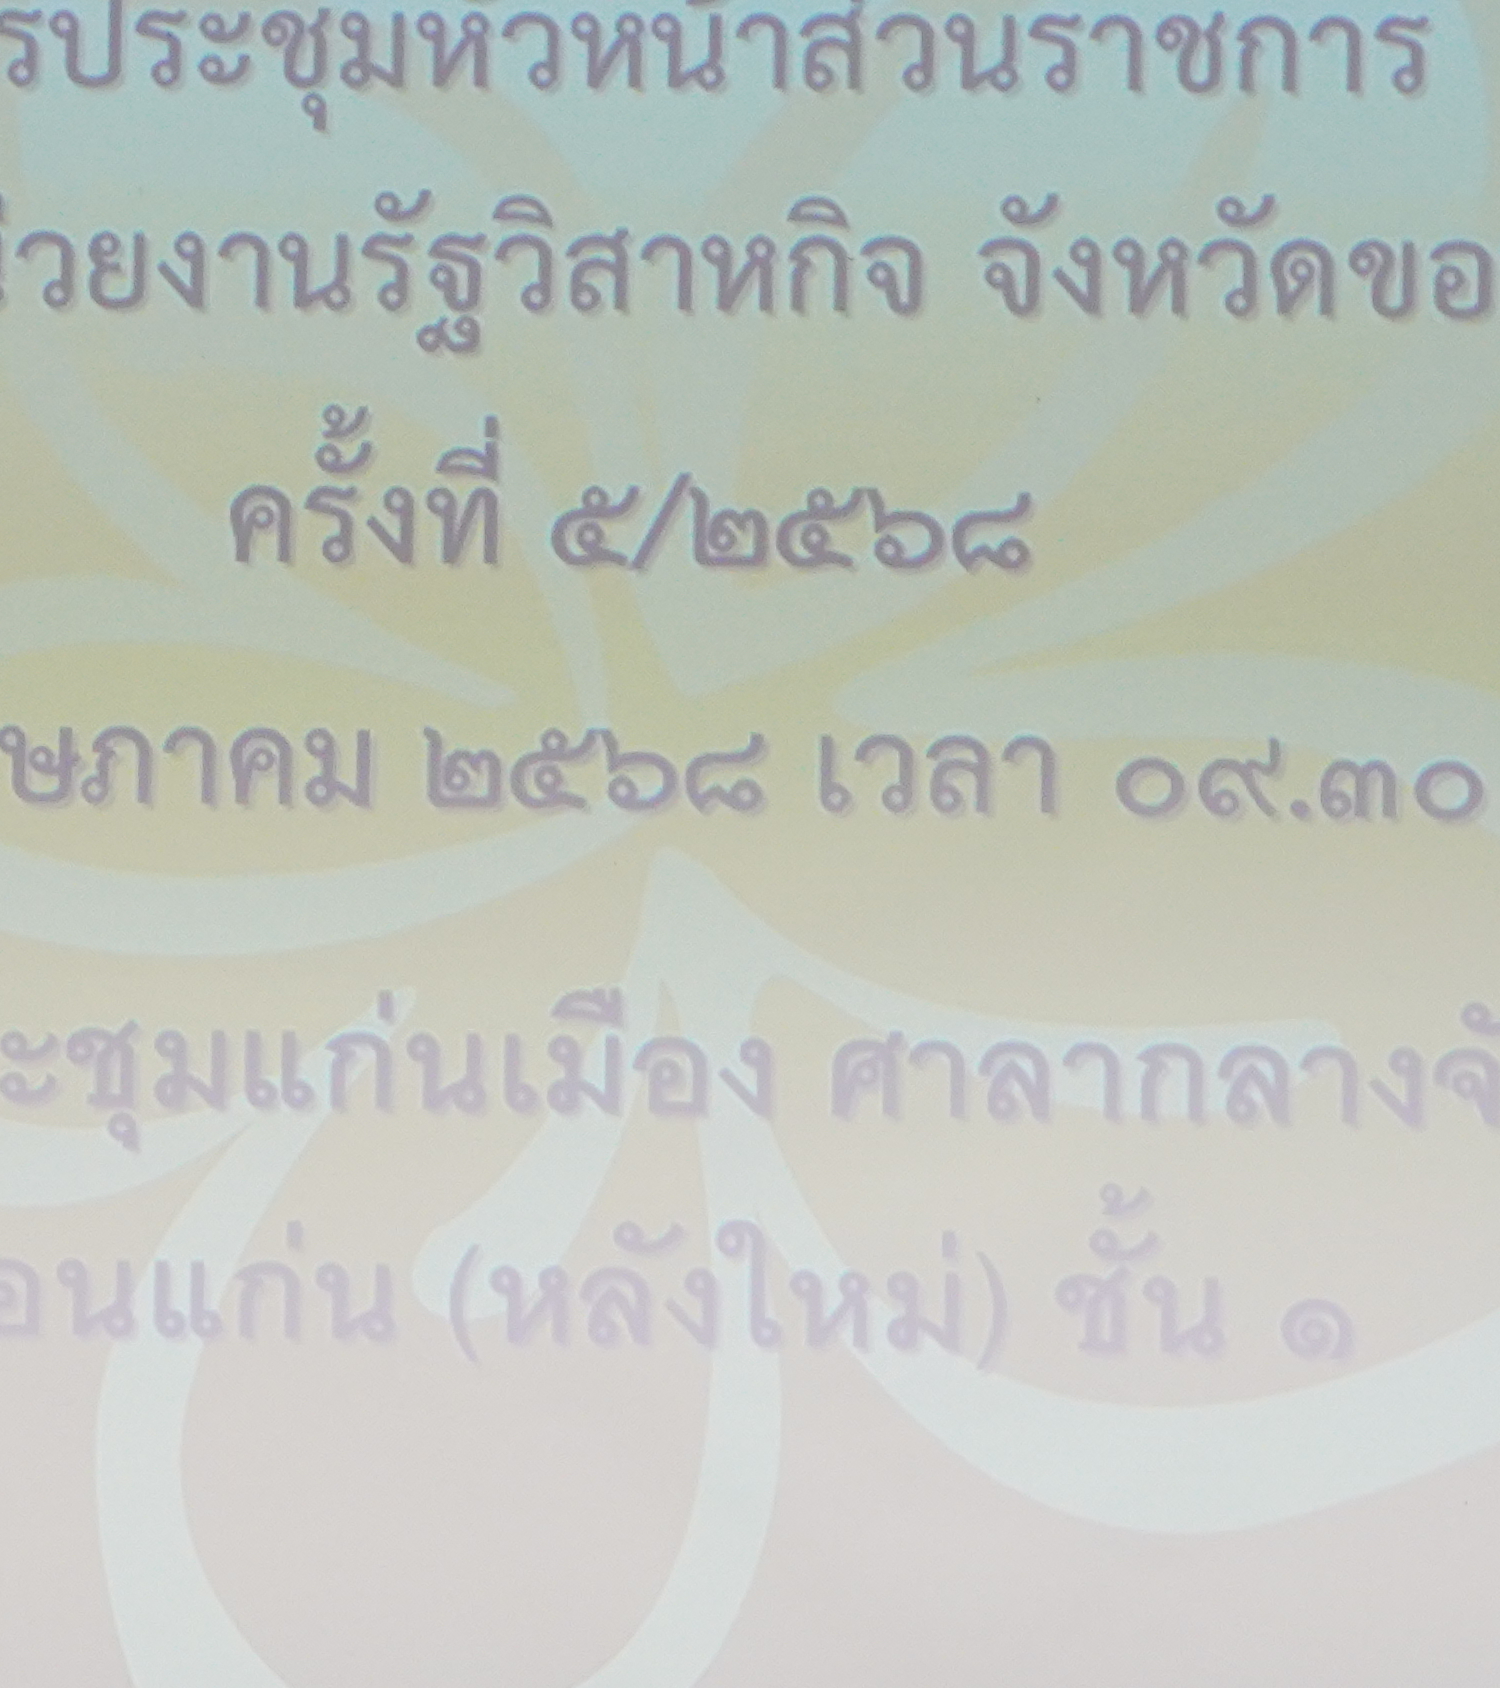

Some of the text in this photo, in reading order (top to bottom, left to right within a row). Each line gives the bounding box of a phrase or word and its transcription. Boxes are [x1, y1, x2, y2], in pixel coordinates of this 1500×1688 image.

[227, 403, 1034, 575] ครั้งที่ ๕/๒๕๖๘
[421, 721, 769, 815] ๒๕๖๘
[818, 730, 1059, 817] เวลา
[1114, 733, 1487, 826] ๐๙.๓๐
[447, 1217, 1009, 1369] (หลังใหม่)
[1053, 1180, 1229, 1360] ชั้น
[1278, 1295, 1358, 1366] ๑
